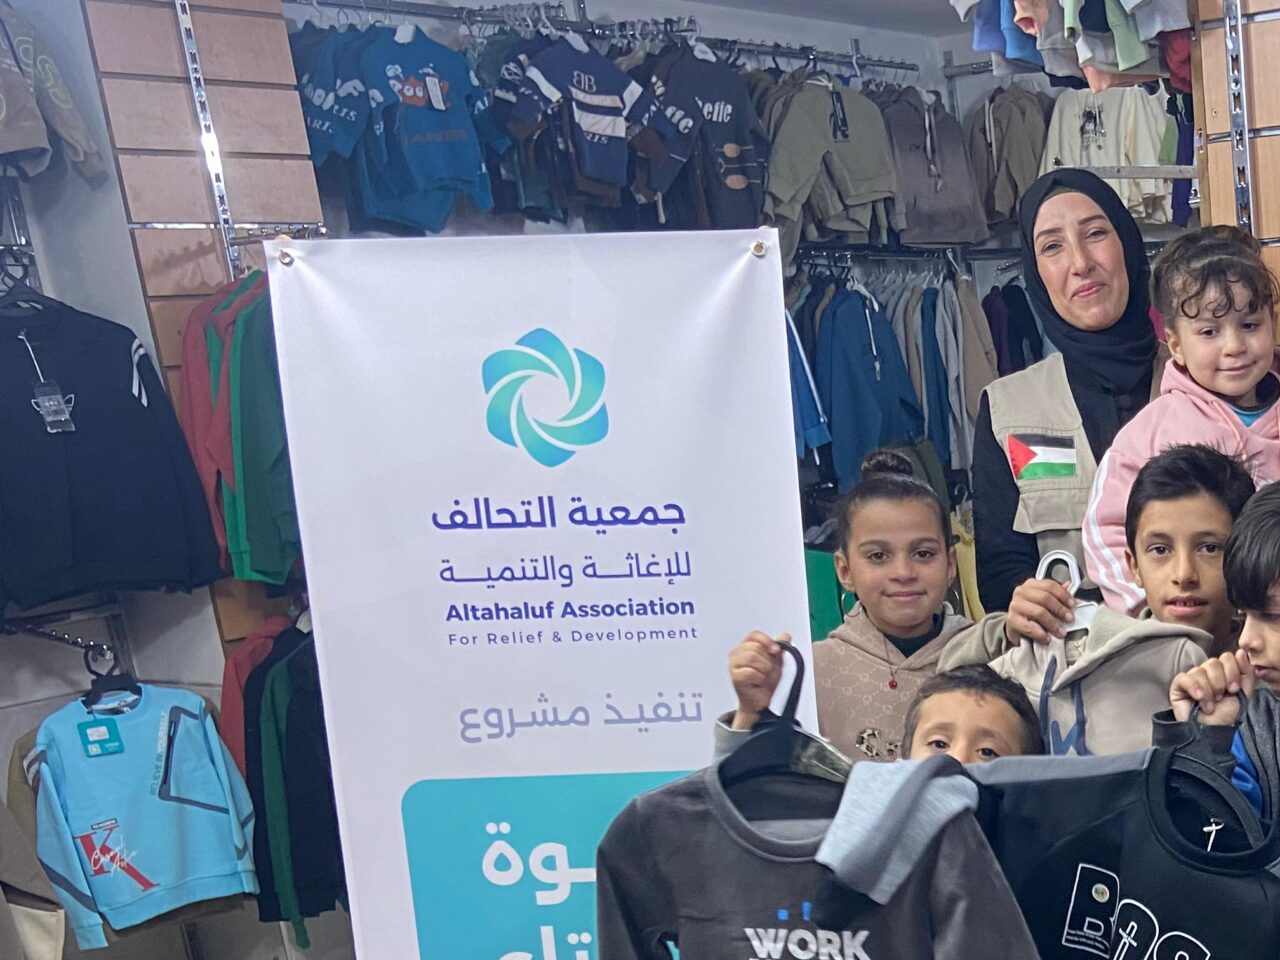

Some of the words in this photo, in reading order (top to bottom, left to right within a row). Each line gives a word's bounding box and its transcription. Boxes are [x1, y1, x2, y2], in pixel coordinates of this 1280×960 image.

[431, 495, 557, 531] التحالف
[568, 496, 686, 535] جمعية
[439, 554, 574, 589] والتنمية
[581, 551, 692, 586] للإغاثة
[445, 600, 555, 622] Altahaluf
[560, 596, 695, 619] Association
[448, 632, 478, 646] For
[486, 630, 544, 645] Relief
[552, 631, 563, 643] &
[570, 626, 698, 643] Development
[459, 692, 591, 744] مشروع
[603, 691, 704, 734] تنفيذ
